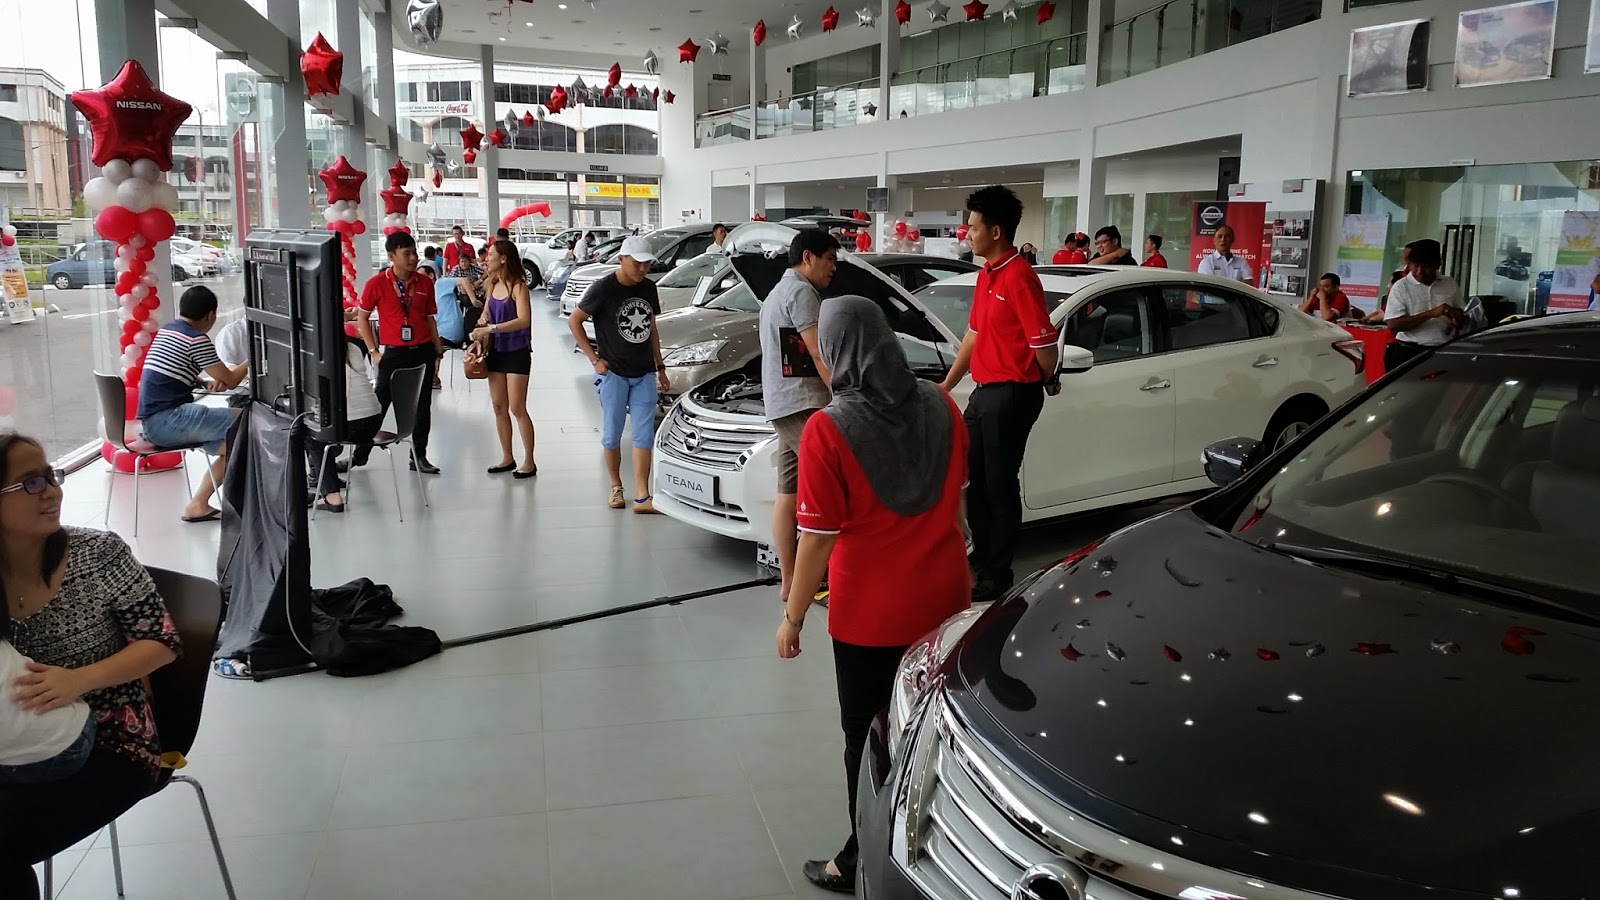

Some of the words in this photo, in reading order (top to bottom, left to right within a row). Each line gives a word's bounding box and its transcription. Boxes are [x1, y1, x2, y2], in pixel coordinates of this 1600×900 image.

[116, 101, 161, 110] NISSAN
[621, 301, 651, 316] CONVERSE
[665, 473, 703, 493] TEANA
